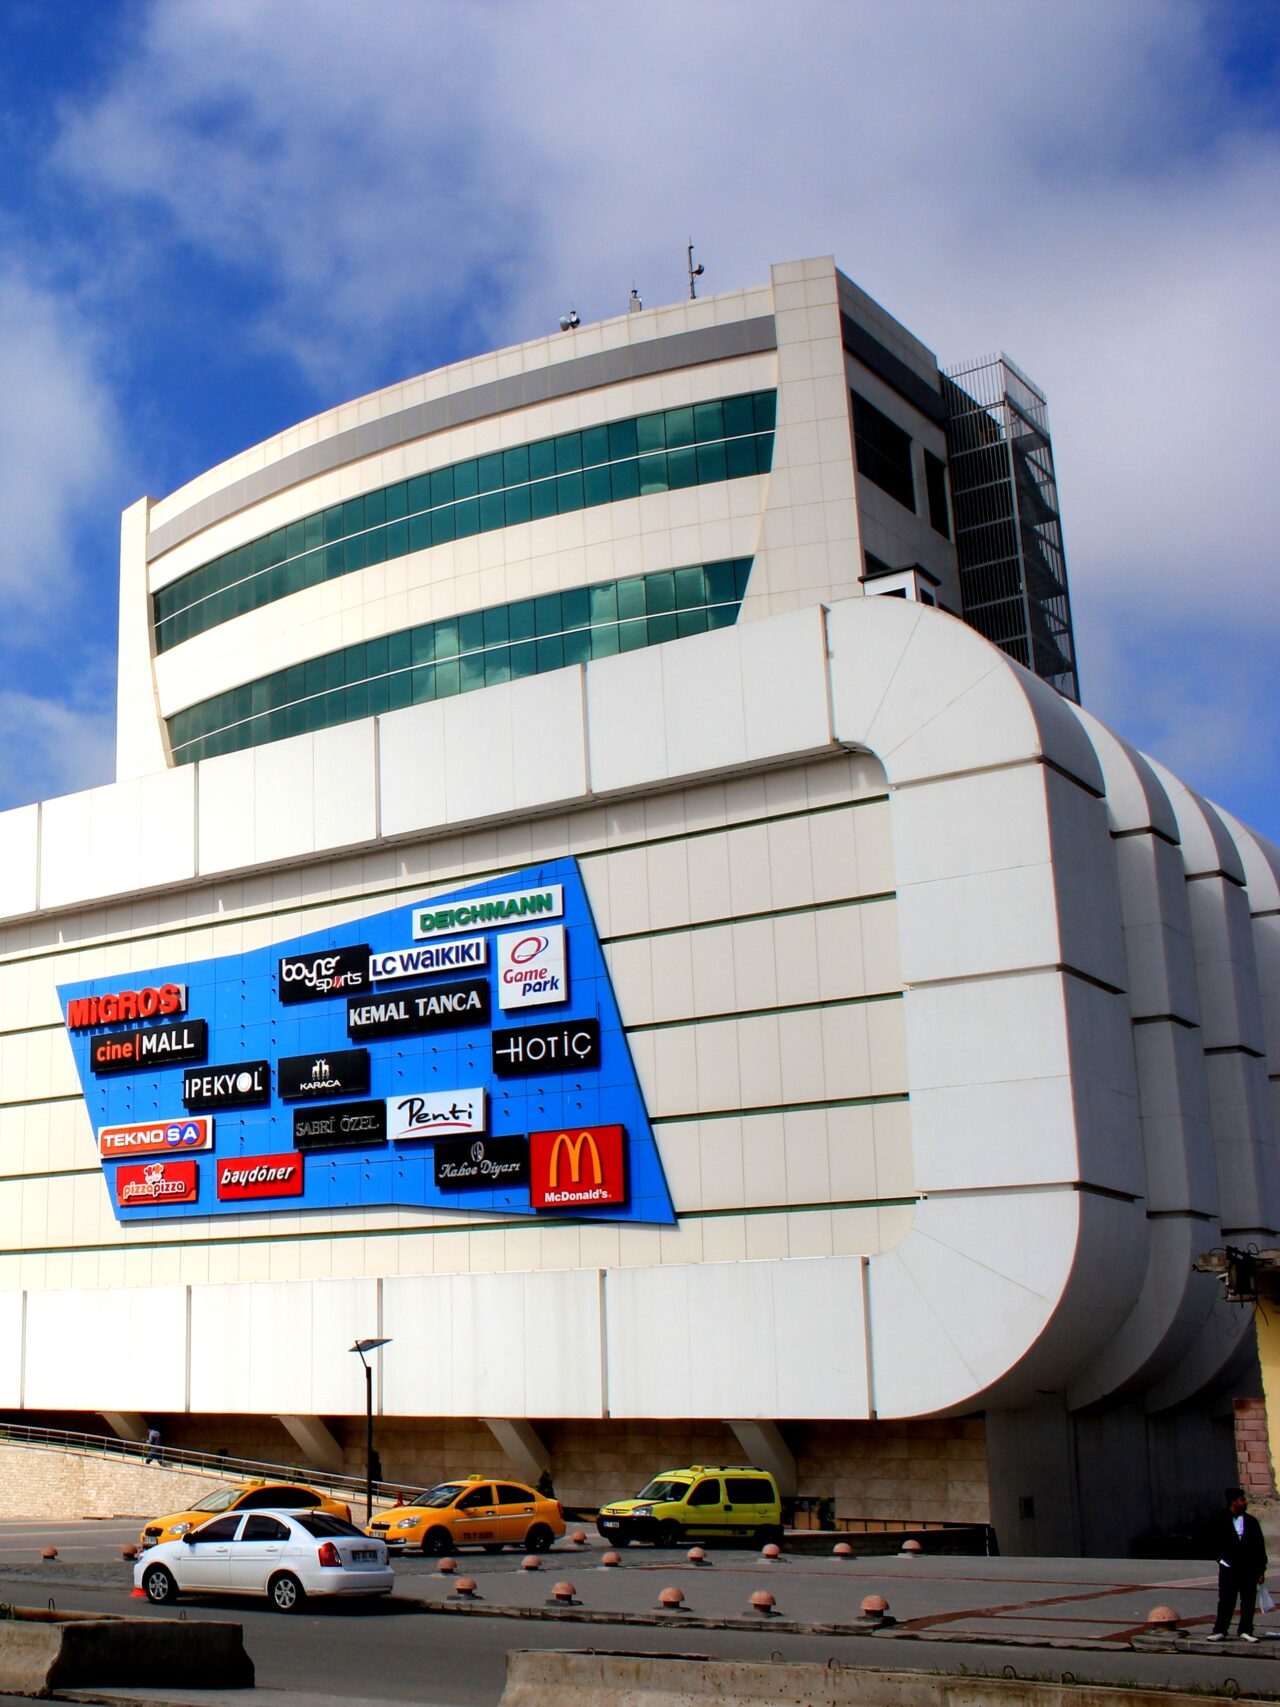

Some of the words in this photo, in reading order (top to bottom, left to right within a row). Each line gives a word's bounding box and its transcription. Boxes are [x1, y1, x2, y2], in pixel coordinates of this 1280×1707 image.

[420, 892, 553, 932] DEICHMANN
[282, 955, 340, 987] boyner
[372, 956, 397, 976] LC
[503, 967, 548, 984] Game
[316, 971, 362, 993] sports
[522, 976, 560, 996] park
[349, 1001, 409, 1026] KEMAL
[415, 990, 482, 1017] TANCA
[185, 1071, 262, 1098] IPEKYOL
[300, 1079, 342, 1091] KARACA
[397, 1097, 473, 1127] Penti
[221, 1165, 294, 1187] baydöner
[544, 1188, 609, 1203] McDonald's
